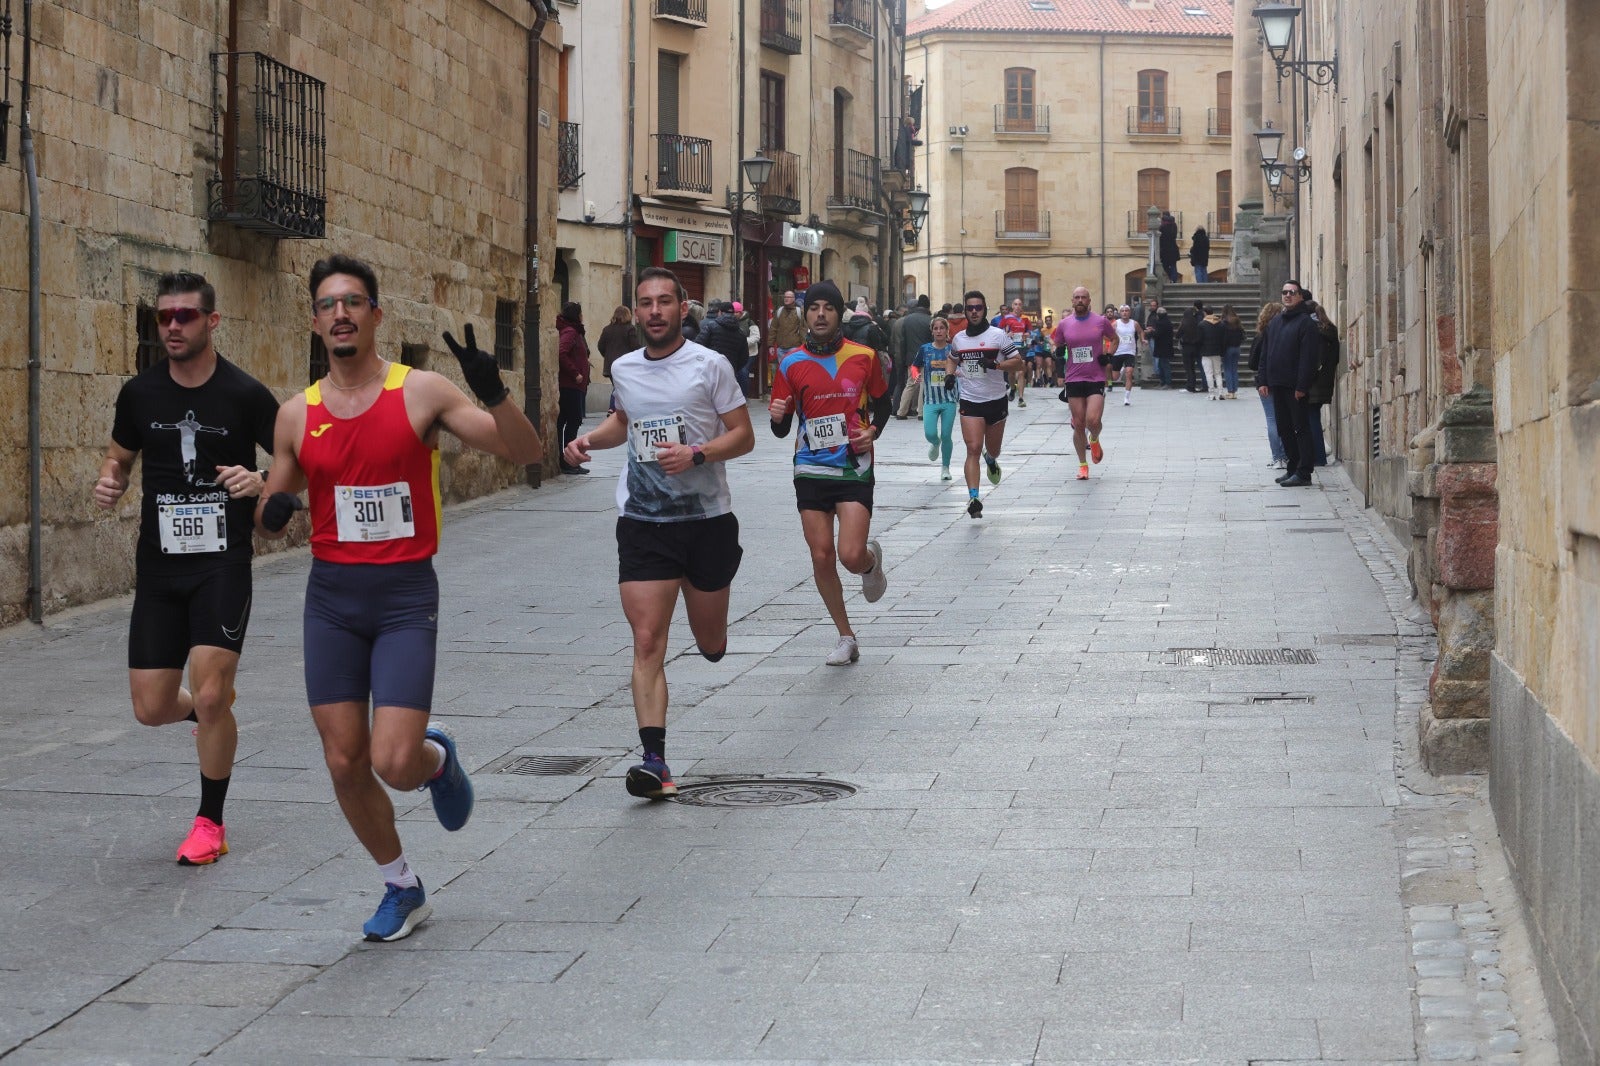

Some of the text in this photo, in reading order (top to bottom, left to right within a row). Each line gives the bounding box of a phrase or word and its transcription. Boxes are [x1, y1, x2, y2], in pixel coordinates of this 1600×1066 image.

[656, 214, 668, 224] away
[682, 240, 716, 260] SCALE
[642, 418, 678, 428] SETEL
[814, 416, 841, 425] SETEL
[814, 424, 834, 438] 403
[642, 428, 668, 447] 736
[354, 486, 402, 498] SETEL
[156, 494, 186, 504] PABLO
[175, 506, 218, 516] SETEL
[354, 501, 384, 522] 301
[172, 518, 204, 536] 566
